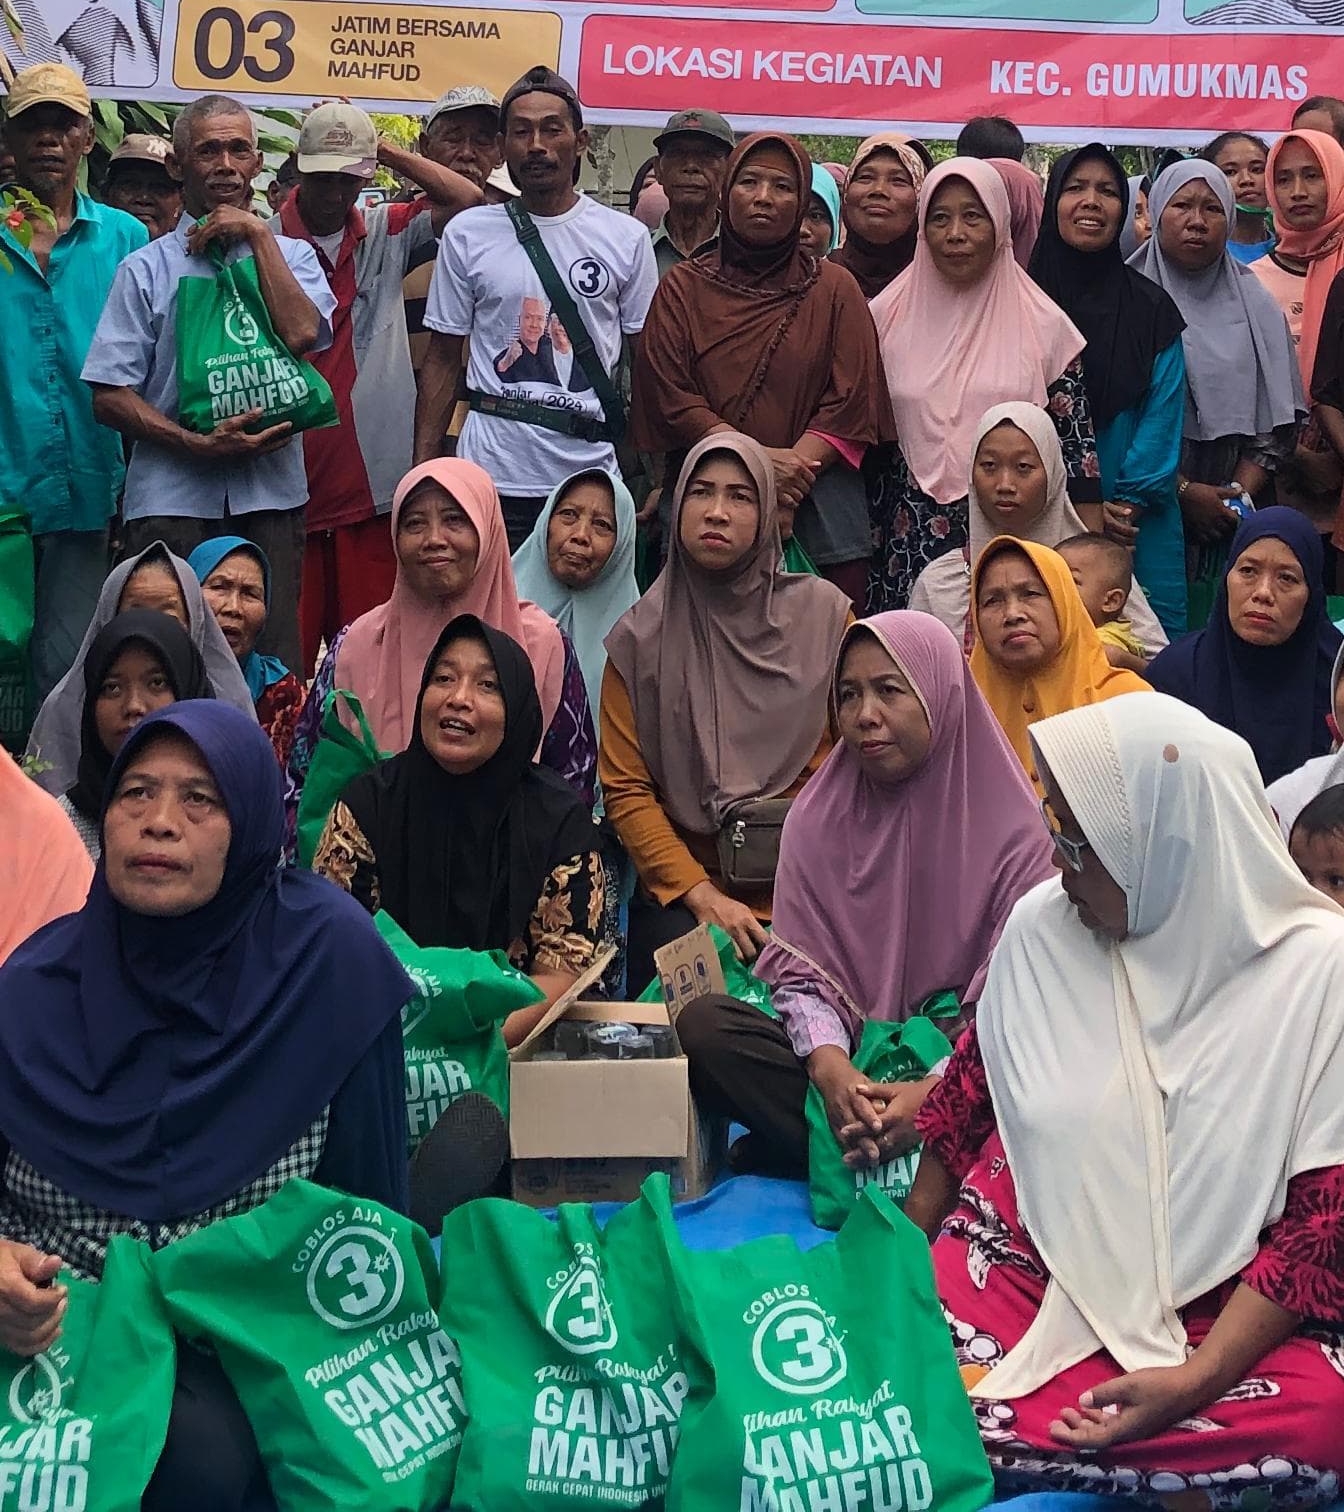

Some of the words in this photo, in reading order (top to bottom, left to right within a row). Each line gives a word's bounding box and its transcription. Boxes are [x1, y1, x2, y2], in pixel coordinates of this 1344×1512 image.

[193, 6, 296, 84] 03
[329, 37, 416, 60] GANJAR
[330, 15, 393, 37] JATIM
[396, 17, 501, 40] BERSAMA
[327, 60, 421, 83] MAHFUD
[603, 43, 743, 80] LOKASI
[752, 48, 943, 88] KEGIATAN
[990, 60, 1071, 97] KEC.
[1086, 62, 1309, 100] GUMUKMAS
[578, 261, 602, 294] 3
[207, 357, 300, 395] GANJAR
[210, 375, 310, 419] MAHFUD
[548, 394, 583, 411] 2024
[404, 1059, 473, 1102] JAR
[291, 1209, 347, 1274] COBLOS
[351, 1206, 384, 1226] AJA
[325, 1241, 387, 1317] 3
[567, 1270, 604, 1339] 3
[742, 1283, 810, 1325] COBLOS
[304, 1336, 379, 1389] Pilihan
[375, 1309, 440, 1347] Raky
[775, 1314, 834, 1381] 3
[323, 1328, 463, 1427] GANJA
[810, 1380, 895, 1420] Rakyat
[527, 1425, 683, 1488] MAHFU
[526, 1478, 559, 1494] GERAK
[562, 1481, 595, 1497] CEPAT
